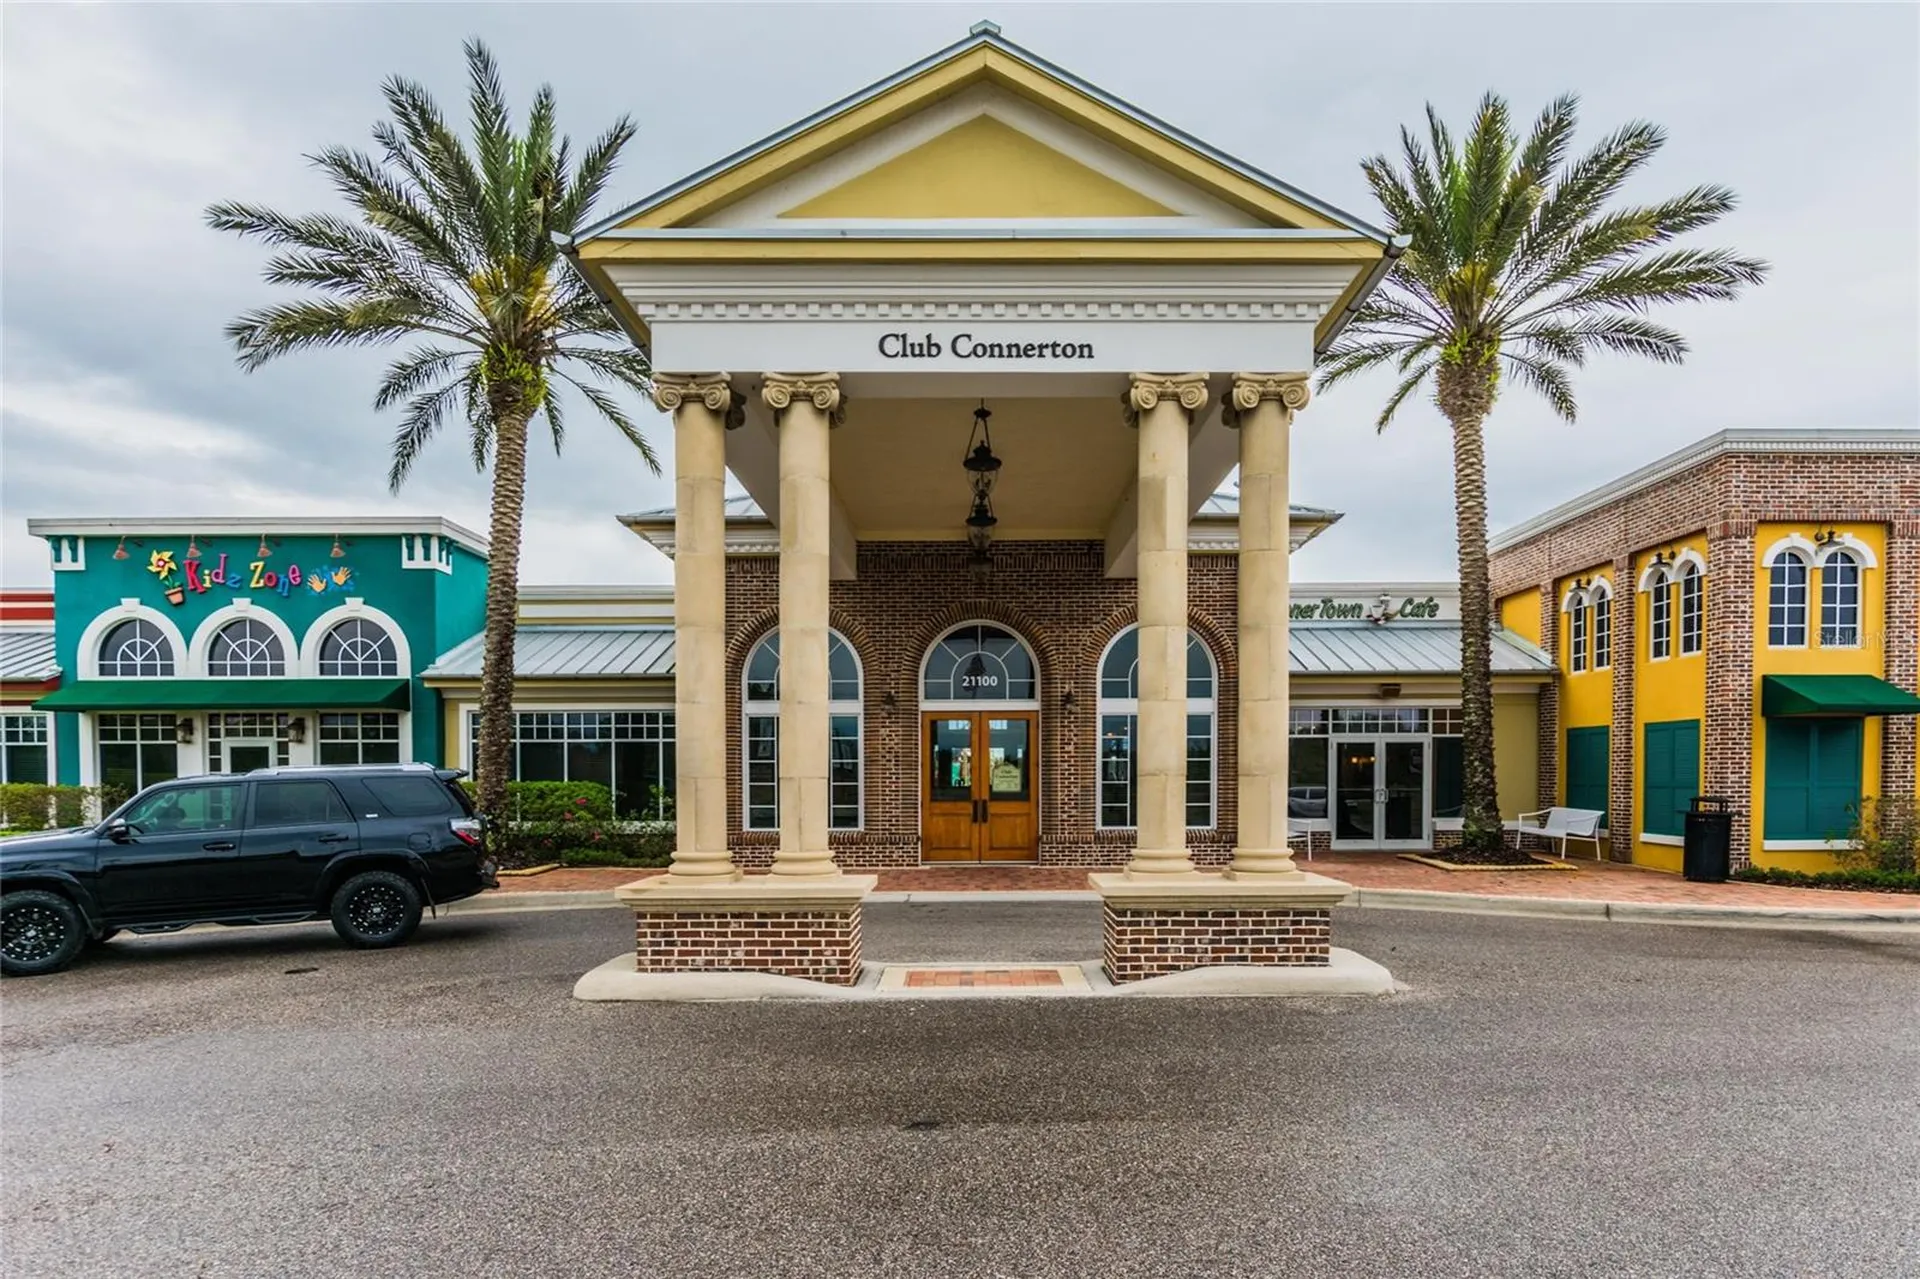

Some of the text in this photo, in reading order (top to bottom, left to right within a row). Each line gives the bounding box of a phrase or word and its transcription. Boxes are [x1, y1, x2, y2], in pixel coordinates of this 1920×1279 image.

[878, 333, 1095, 359] Club Connerton
[184, 553, 302, 597] Kidz Zone
[962, 675, 998, 687] 21100
